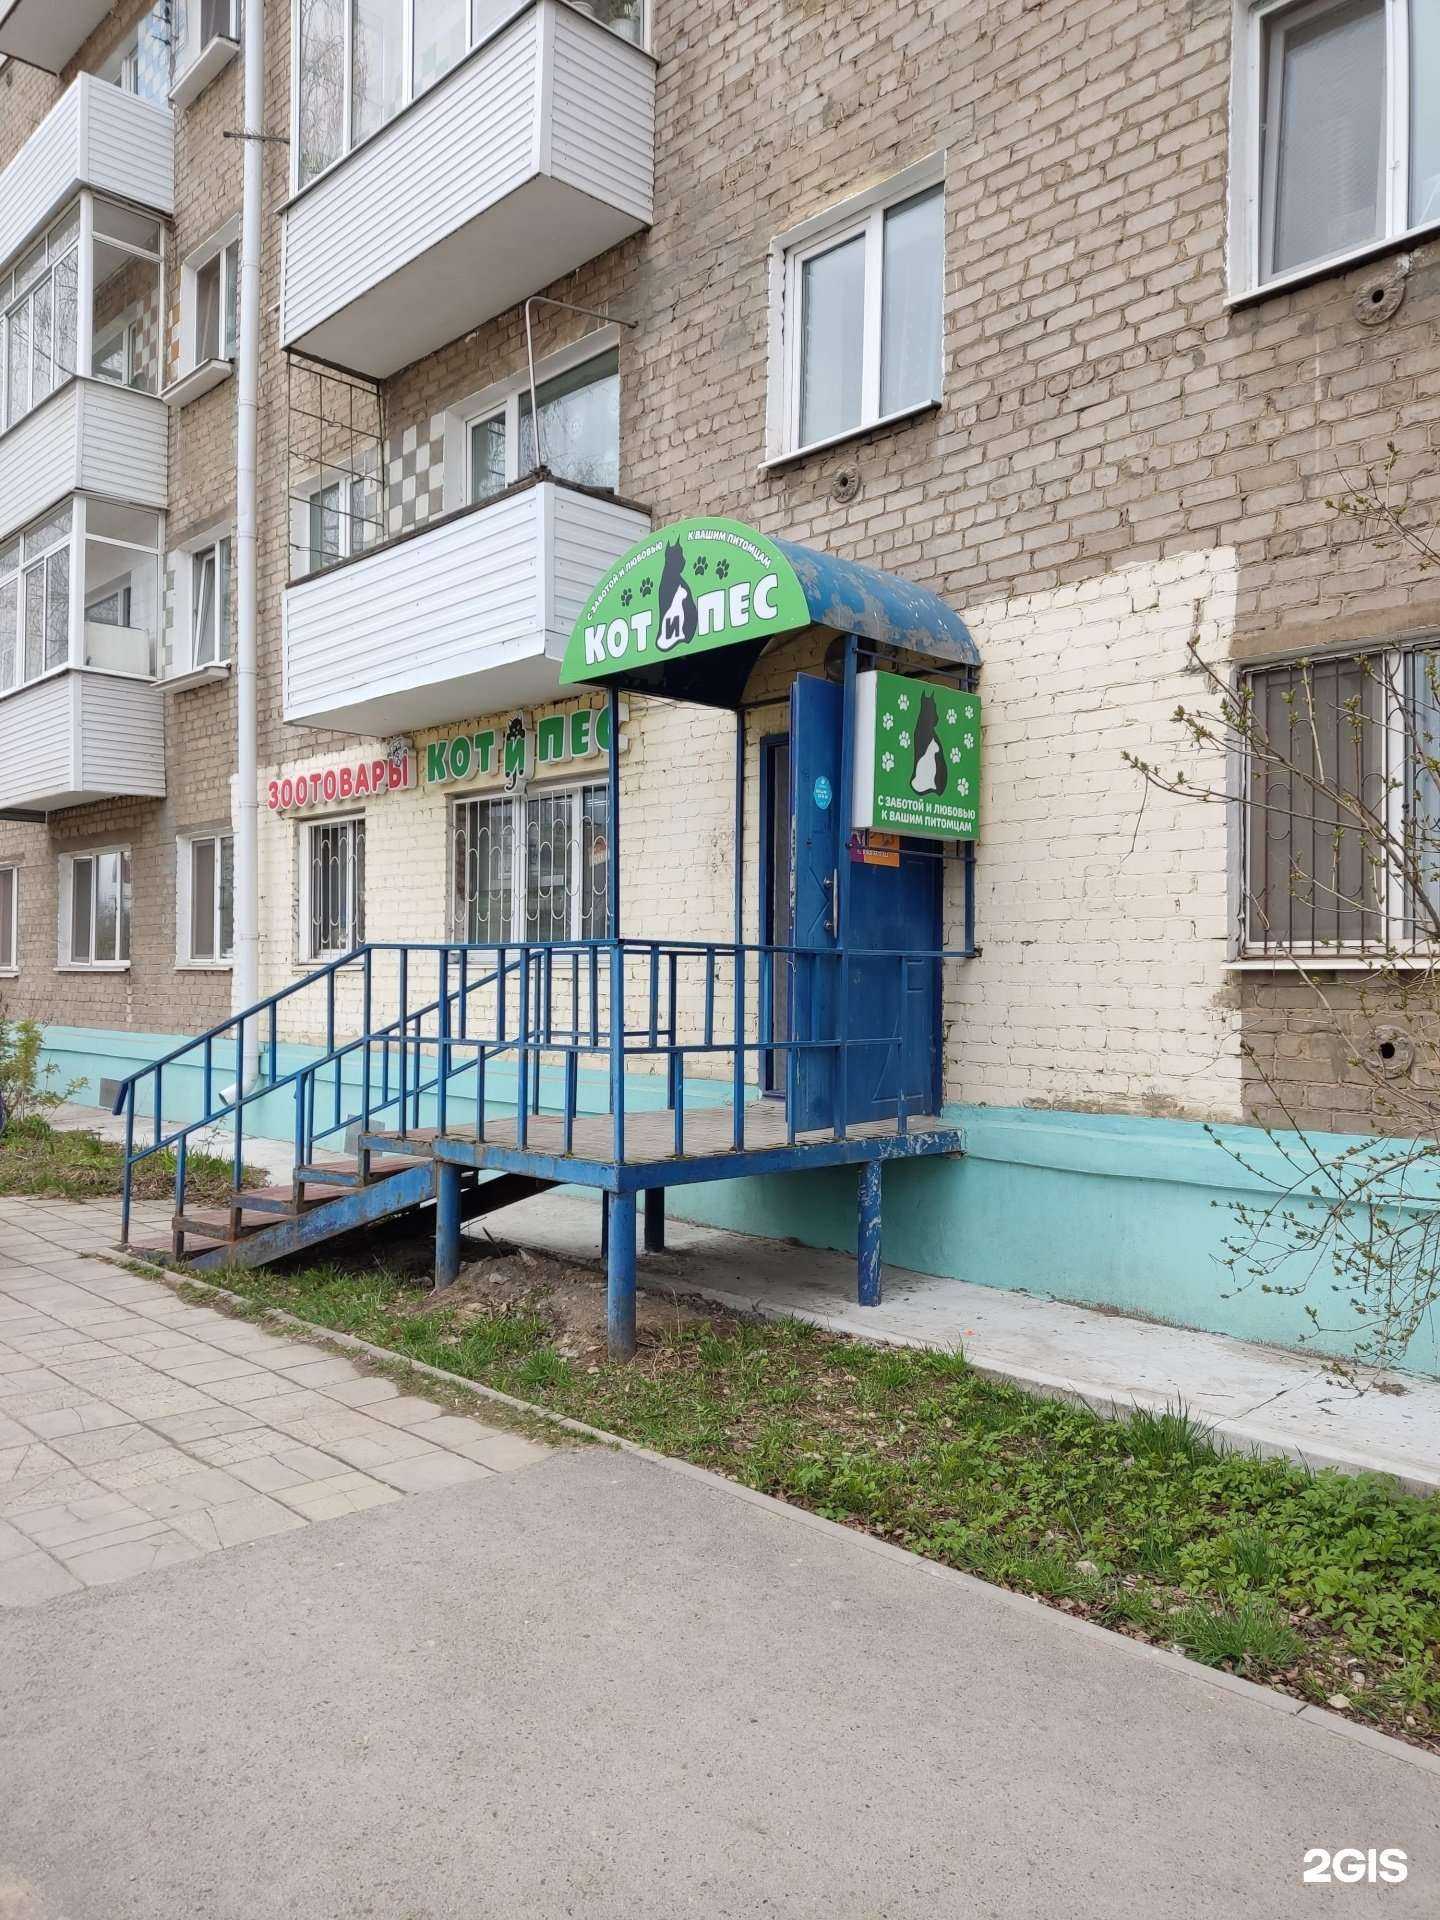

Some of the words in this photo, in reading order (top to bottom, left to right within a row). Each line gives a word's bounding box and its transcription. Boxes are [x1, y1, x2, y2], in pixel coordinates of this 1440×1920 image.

[687, 530, 694, 541] К
[694, 530, 726, 541] ВАШИМ
[727, 533, 771, 569] ПИТОМЦАМ
[587, 612, 593, 621] С
[625, 541, 663, 573] ЛЮБОВЬЮ
[584, 609, 652, 665] КОТ
[697, 573, 778, 636] ПЕС
[267, 748, 408, 809] ЗООТОВАРЫ
[427, 730, 495, 783] КОТ
[878, 795, 884, 805] С
[885, 796, 924, 812] ЗАБОТОЙ
[926, 804, 932, 814] И
[934, 804, 976, 820] ЛЮБОВЬЮ
[881, 810, 888, 820] К
[889, 811, 923, 825] ВАШИМ
[924, 816, 972, 832] ПИТОМЦАМ
